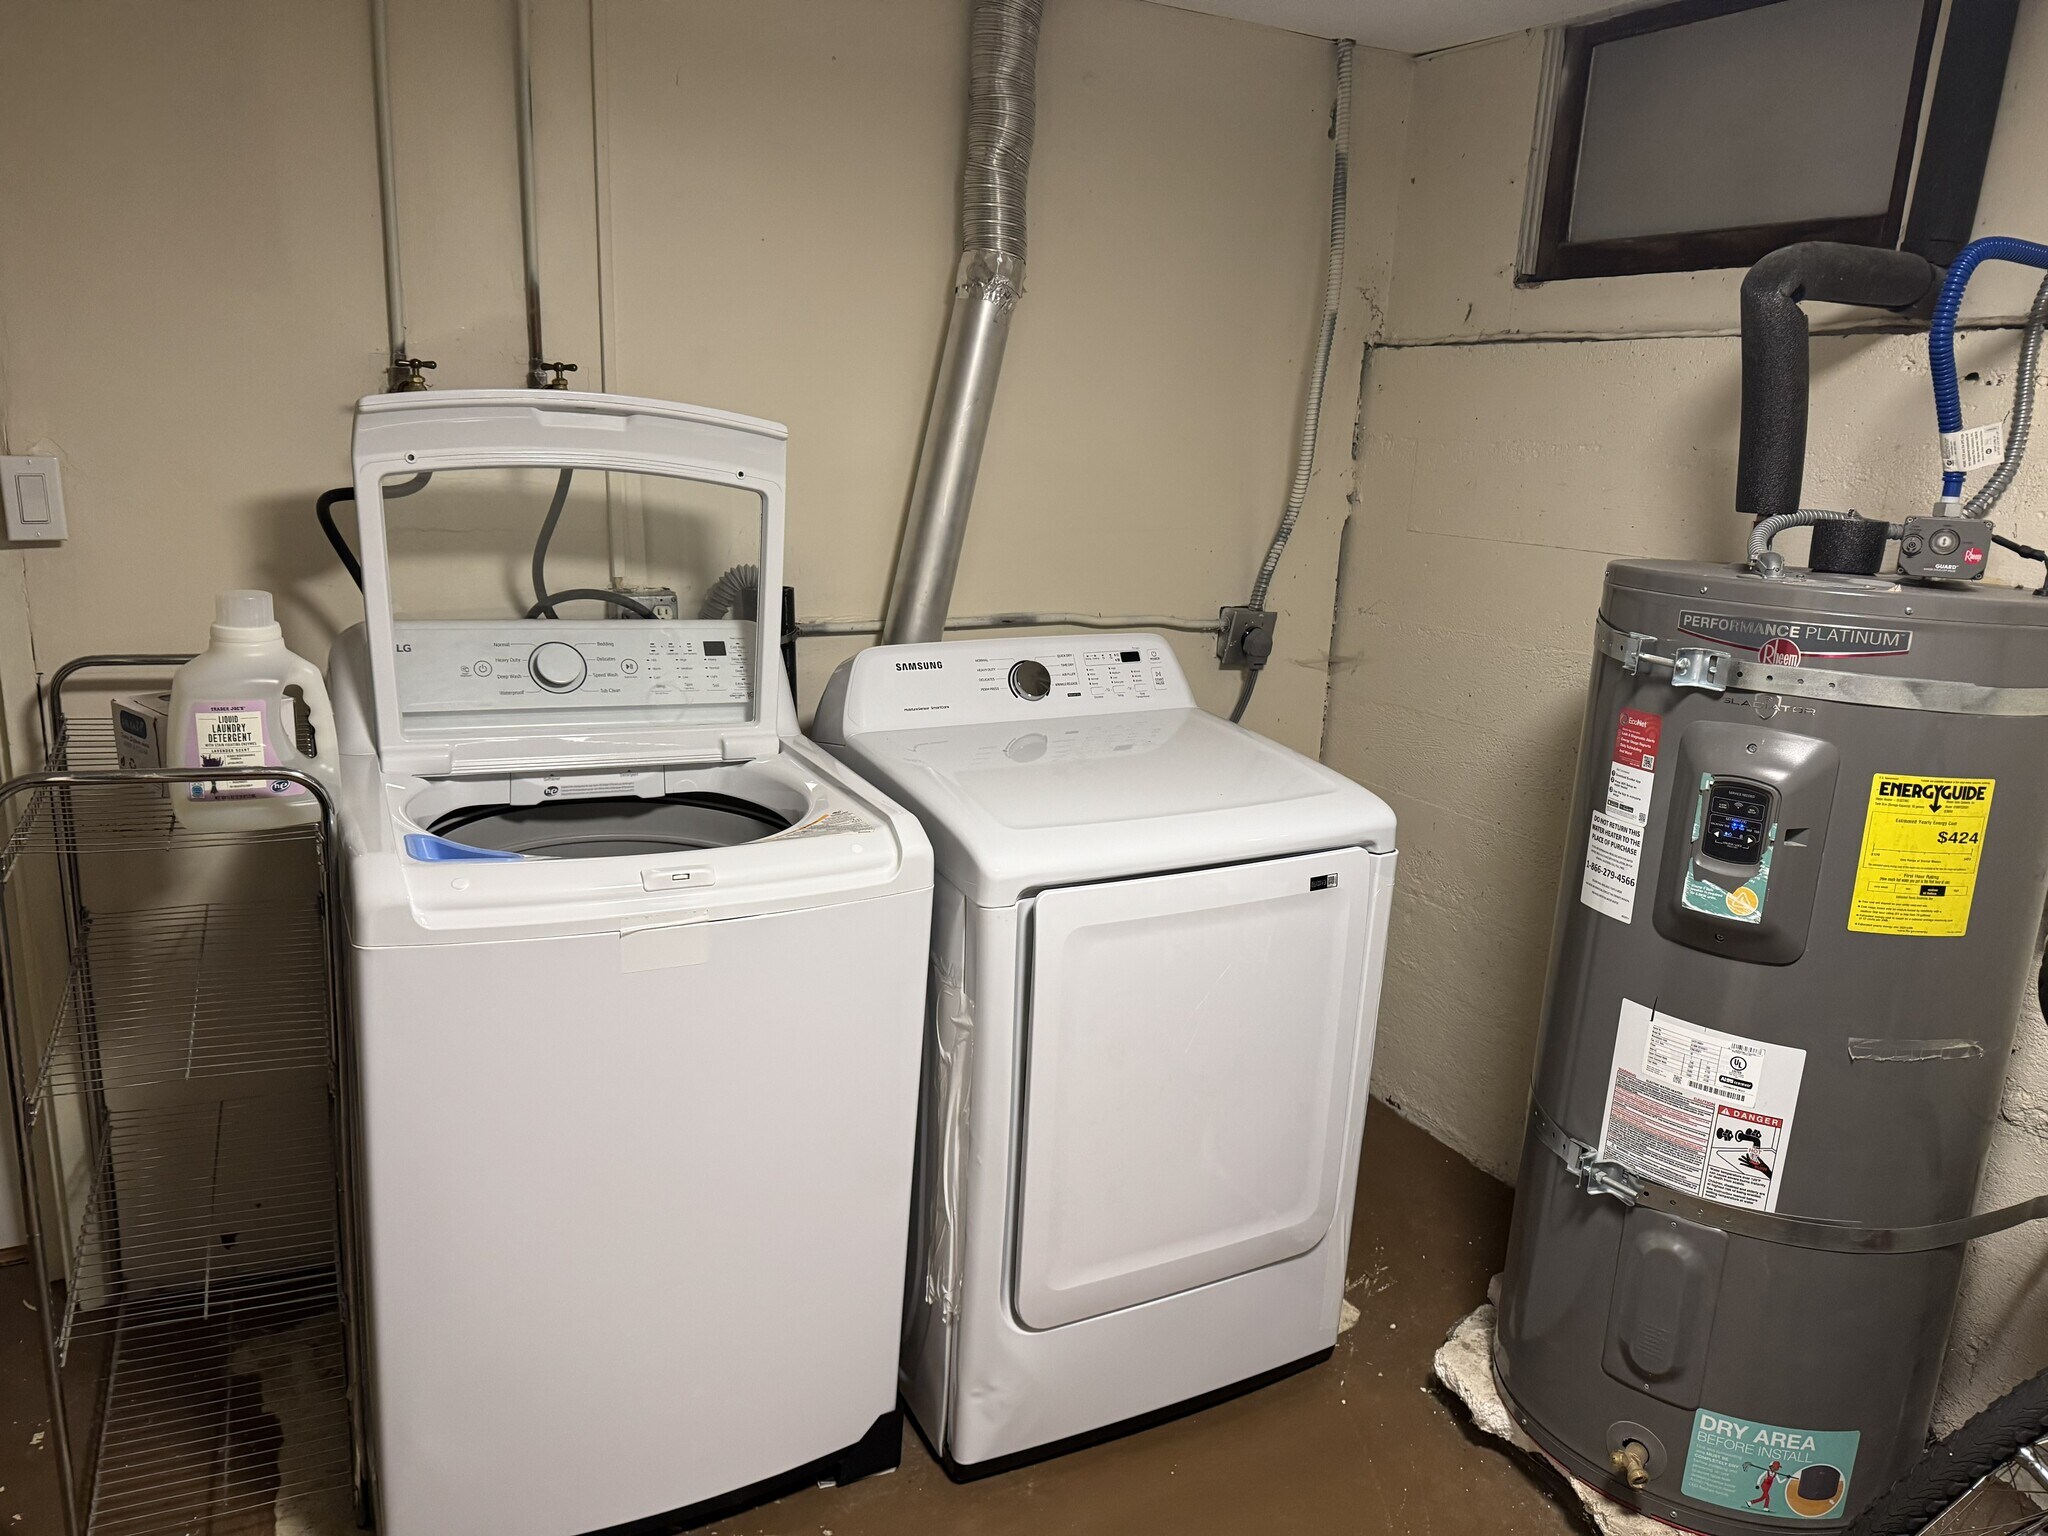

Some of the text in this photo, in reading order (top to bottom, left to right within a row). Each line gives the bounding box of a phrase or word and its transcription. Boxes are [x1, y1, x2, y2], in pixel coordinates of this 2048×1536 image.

[1683, 614, 1900, 647] PERFORMANCE PLATINUM
[396, 644, 412, 653] LG
[1763, 639, 1798, 666] Rheem
[895, 660, 943, 672] SAMSUNG
[212, 723, 246, 733] LAUNDRY
[218, 715, 239, 724] LIQUID
[1628, 717, 1647, 728] EcoNet
[208, 732, 251, 743] DETERGENT
[1879, 781, 1987, 801] ENERGYGUIDE
[1592, 824, 1605, 834] WATER
[1605, 829, 1622, 840] HEATER
[1630, 839, 1641, 847] THE
[1600, 817, 1609, 826] NOT
[1609, 820, 1628, 834] RETURN
[1628, 828, 1640, 837] THIS
[1591, 833, 1637, 856] PLACE OF PURCHASE
[1937, 831, 1979, 845] $424
[1586, 860, 1635, 887] 1-866-279-4566
[1733, 1110, 1779, 1127] DANGER
[1700, 1414, 1816, 1452] DRY AREA
[1697, 1430, 1813, 1463] BEFORE INSTALL
[1706, 1450, 1720, 1460] MUST
[1694, 1453, 1728, 1466] COMPLETELY
